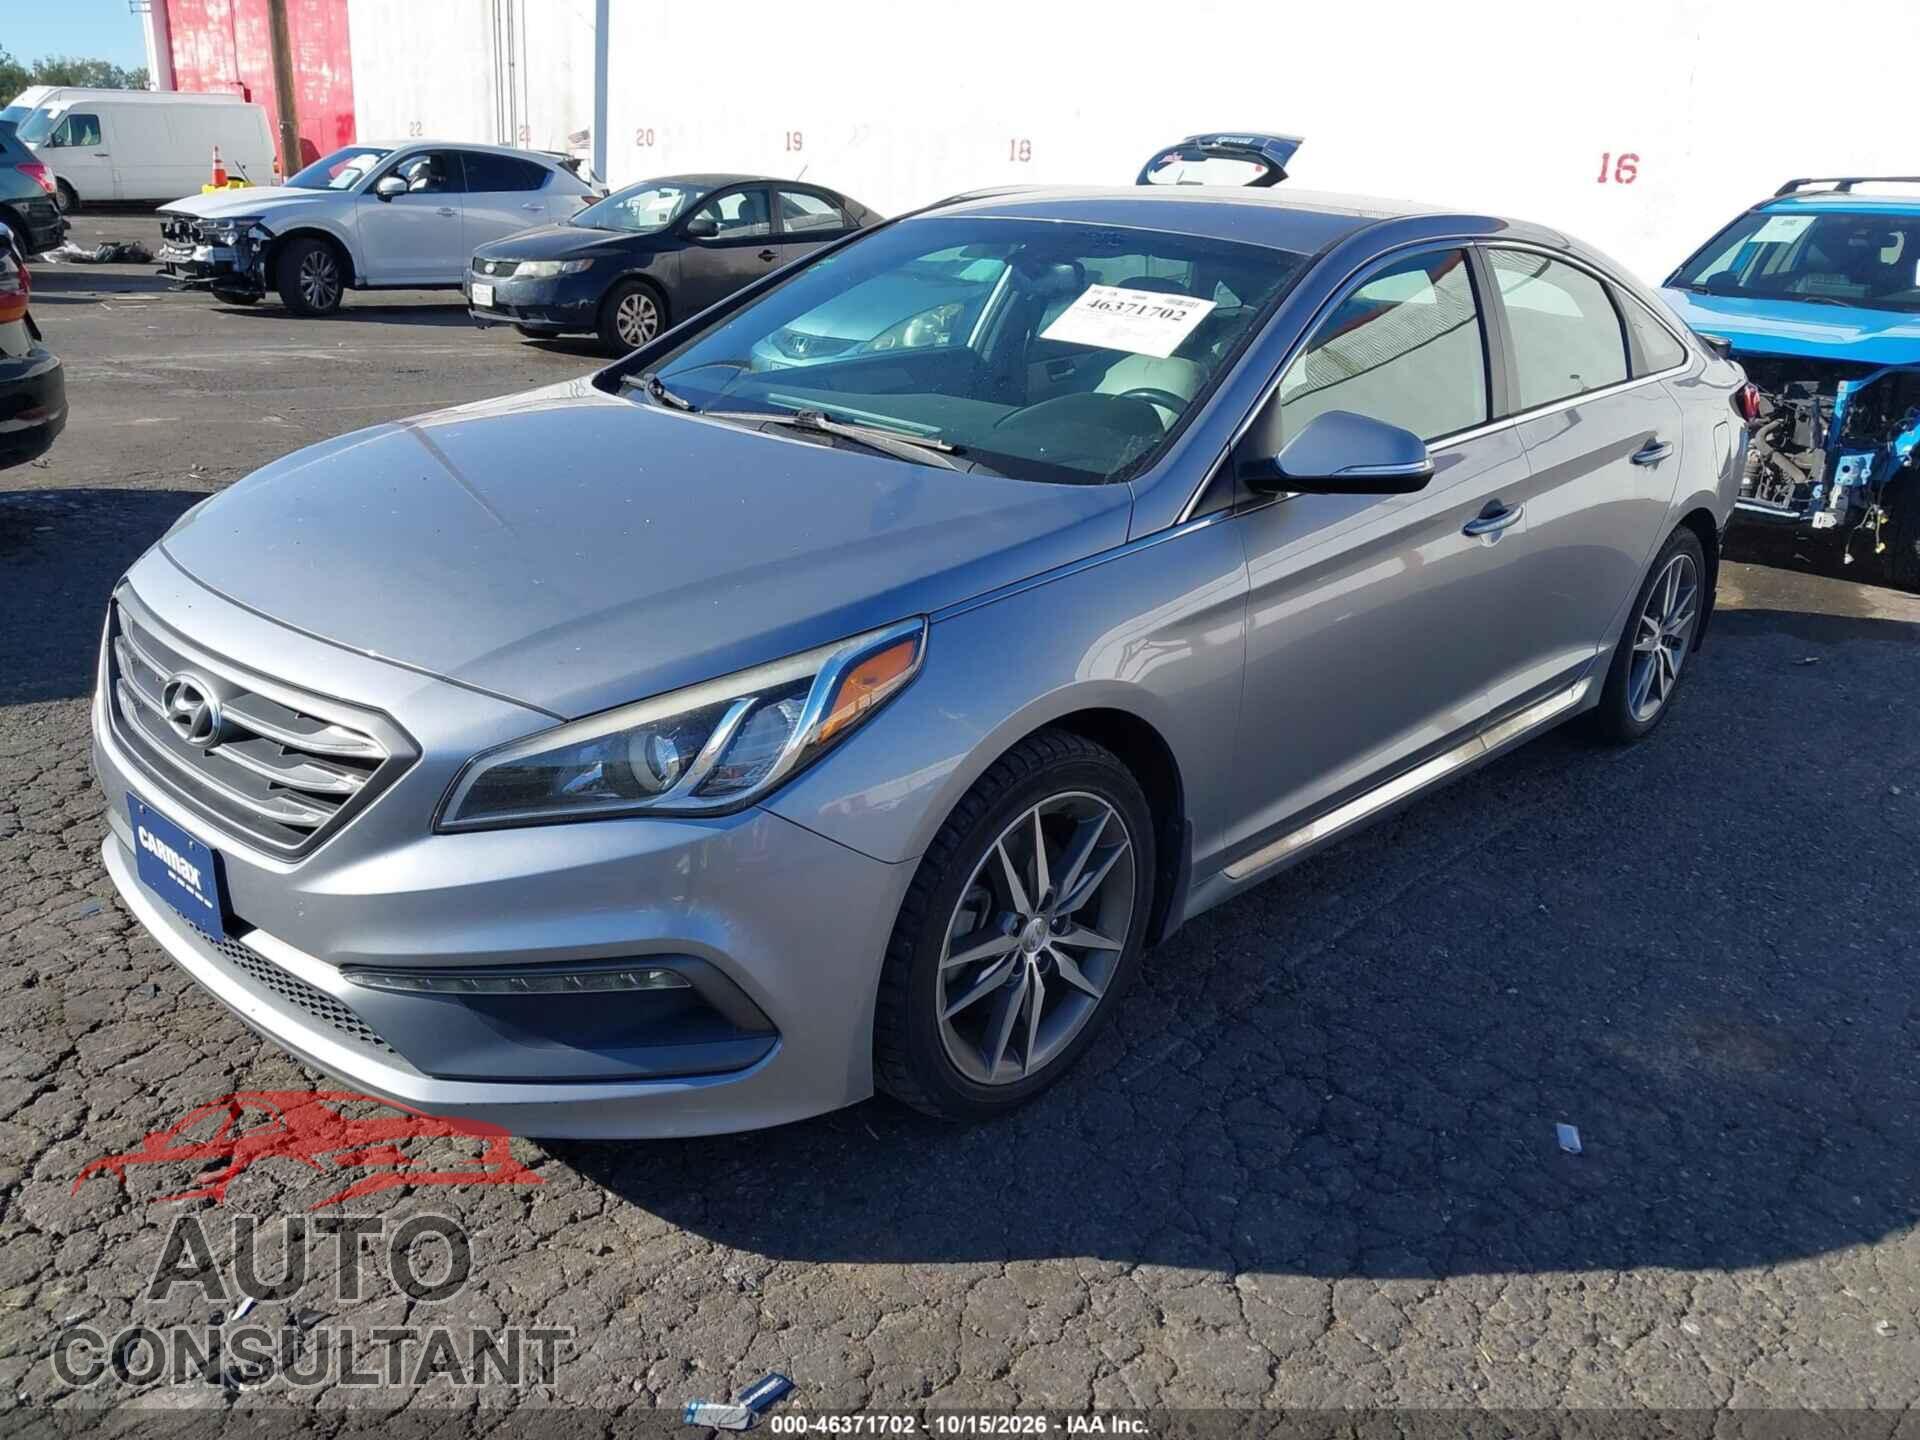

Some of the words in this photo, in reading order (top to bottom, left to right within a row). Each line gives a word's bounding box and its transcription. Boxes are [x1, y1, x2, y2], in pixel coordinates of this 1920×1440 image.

[409, 120, 424, 137] 22
[636, 128, 655, 147] 20
[785, 131, 803, 152] 19
[1009, 138, 1032, 163] 18
[1597, 152, 1641, 185] 16
[1087, 299, 1187, 322] 46371702
